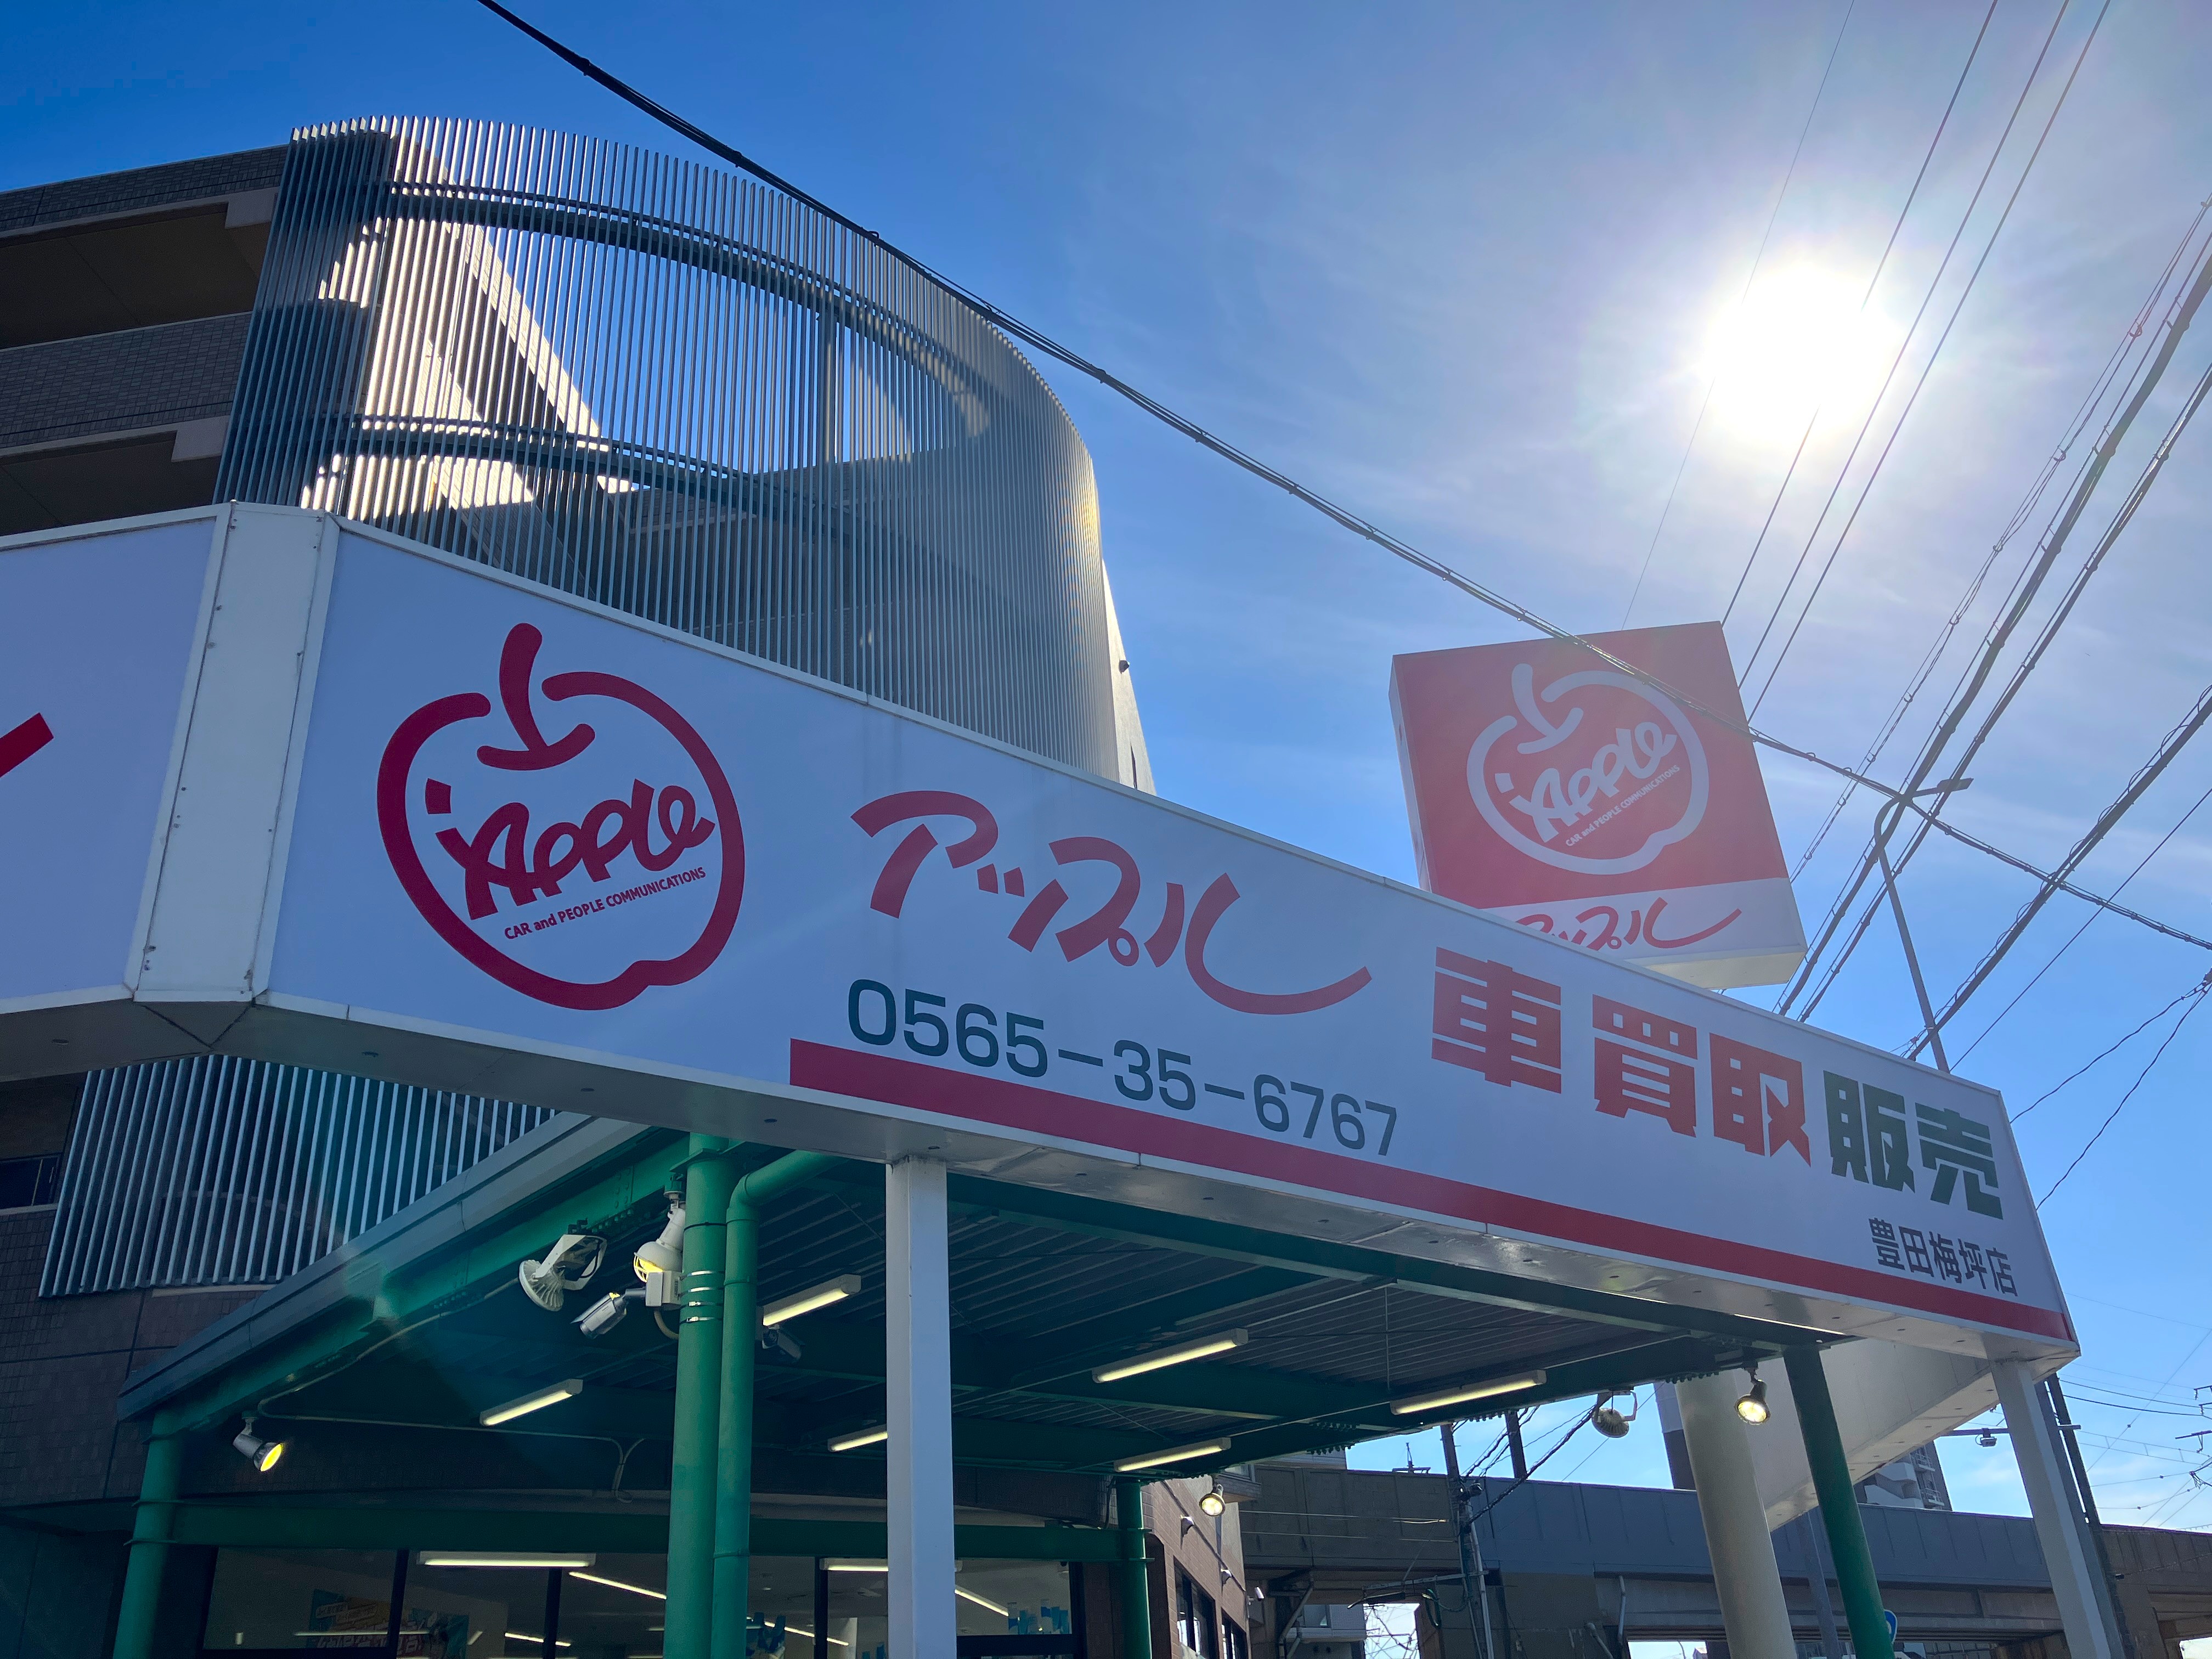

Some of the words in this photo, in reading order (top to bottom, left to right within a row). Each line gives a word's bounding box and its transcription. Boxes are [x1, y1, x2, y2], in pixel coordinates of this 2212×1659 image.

[1509, 721, 1677, 843] Apple
[1565, 833, 1582, 847] CAR
[1581, 822, 1596, 837] and
[1593, 805, 1621, 827] PEOPLE
[1620, 764, 1680, 809] COMMUNICATIONS
[435, 778, 715, 920] Apple
[504, 922, 533, 940] CAR
[534, 913, 558, 931] and
[557, 898, 606, 923] PEOPLE
[606, 866, 707, 907] COMMUNICATIONS
[850, 790, 1373, 1015] アップル
[848, 979, 1397, 1156] 0565-35-6767
[1868, 1217, 2018, 1297] 豊田梅坪店
